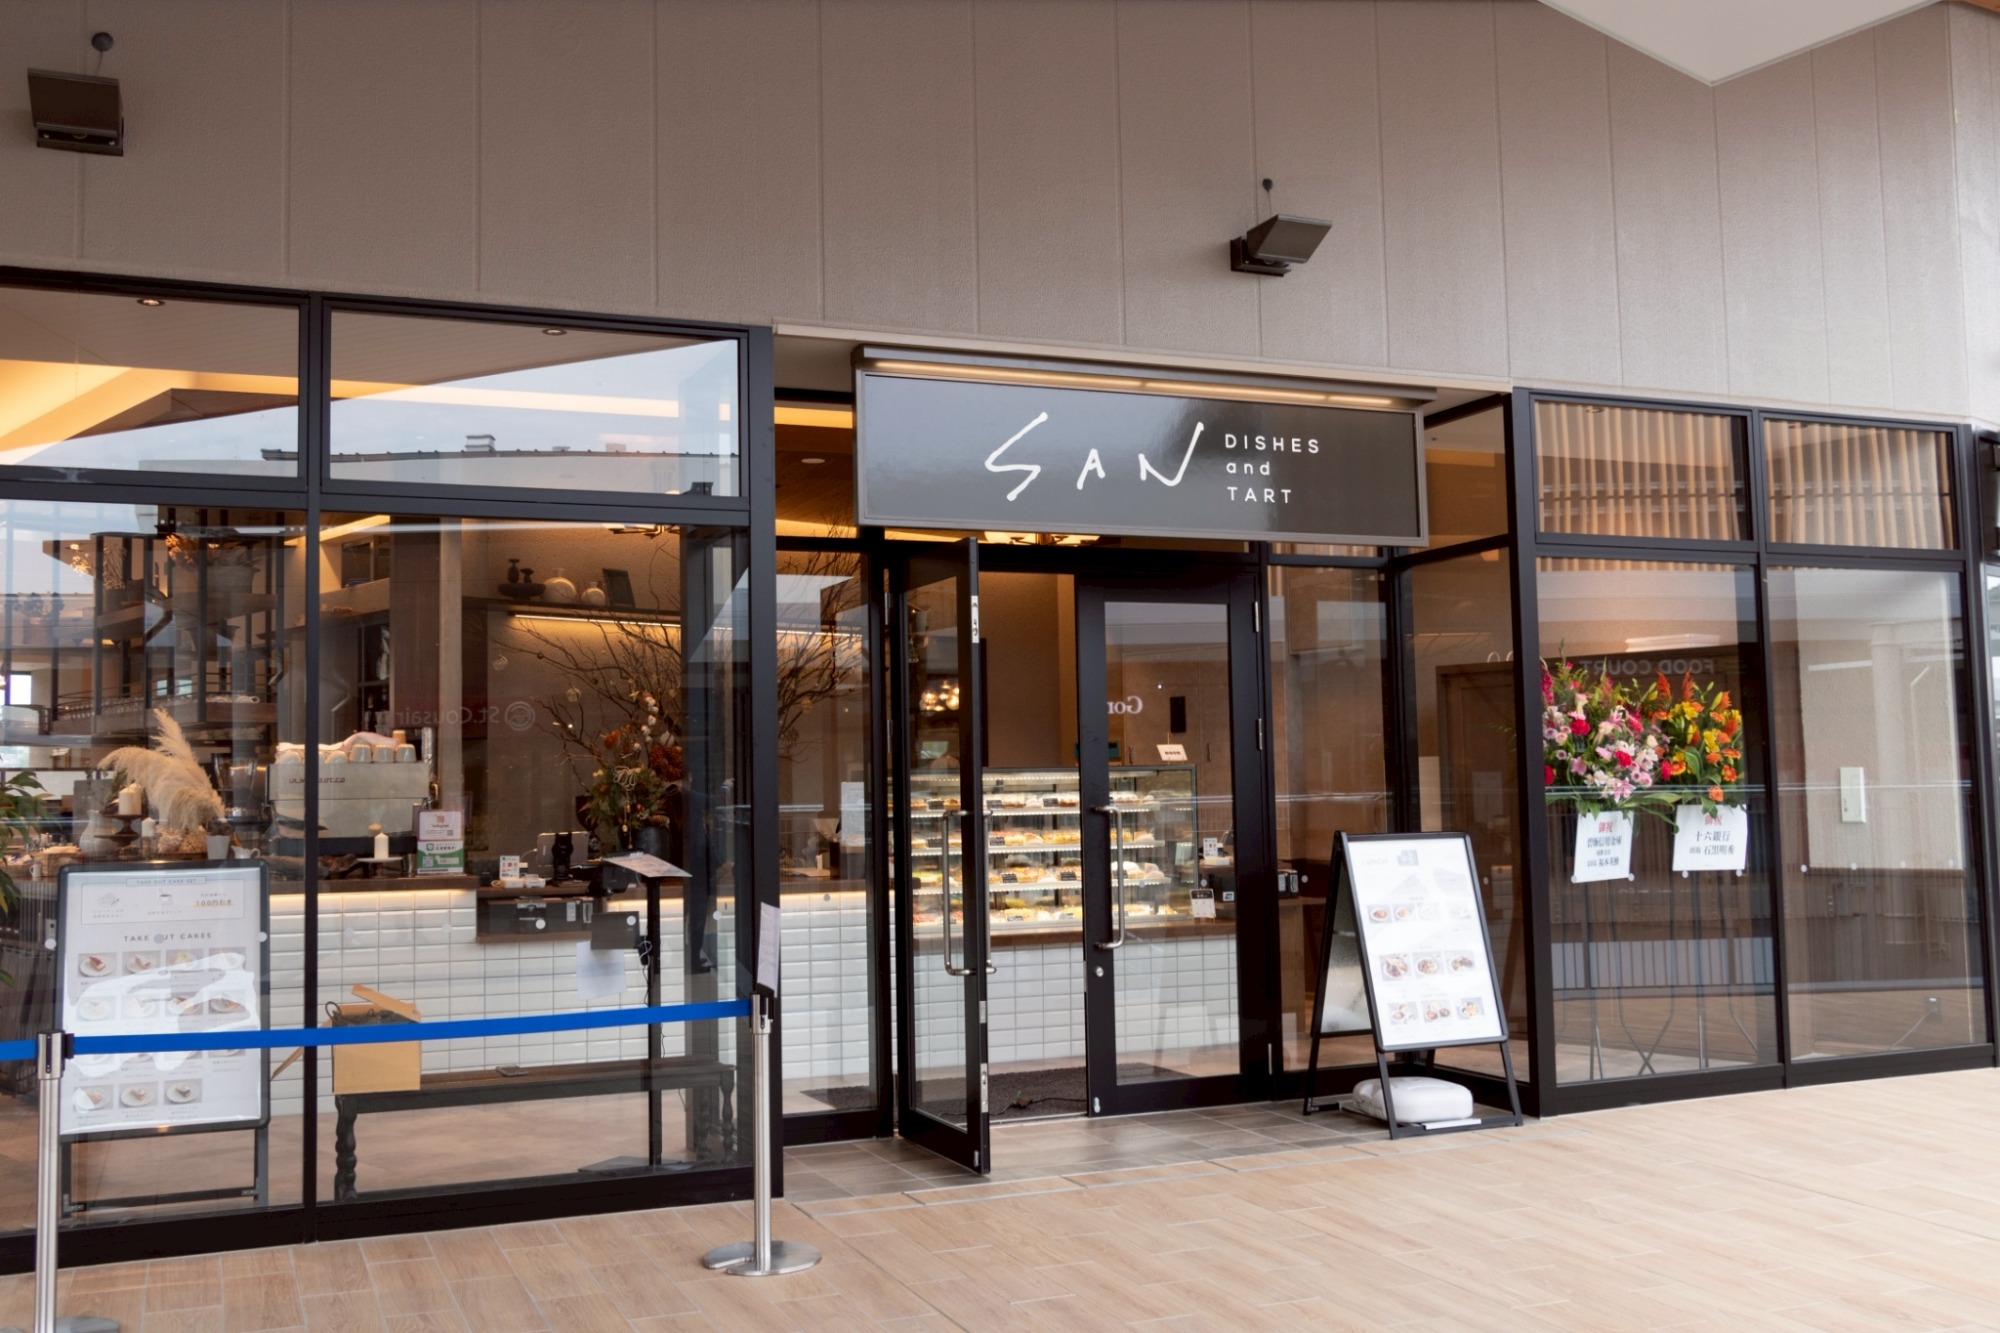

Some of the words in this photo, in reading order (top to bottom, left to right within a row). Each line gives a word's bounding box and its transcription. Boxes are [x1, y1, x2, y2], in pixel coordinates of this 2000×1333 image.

[1225, 433, 1320, 454] DISHES
[984, 411, 1204, 502] SAN
[1226, 460, 1271, 476] and
[1227, 486, 1293, 504] TART
[1695, 830, 1732, 842] 十六銀行
[154, 933, 175, 943] UT
[180, 932, 212, 940] CAKES
